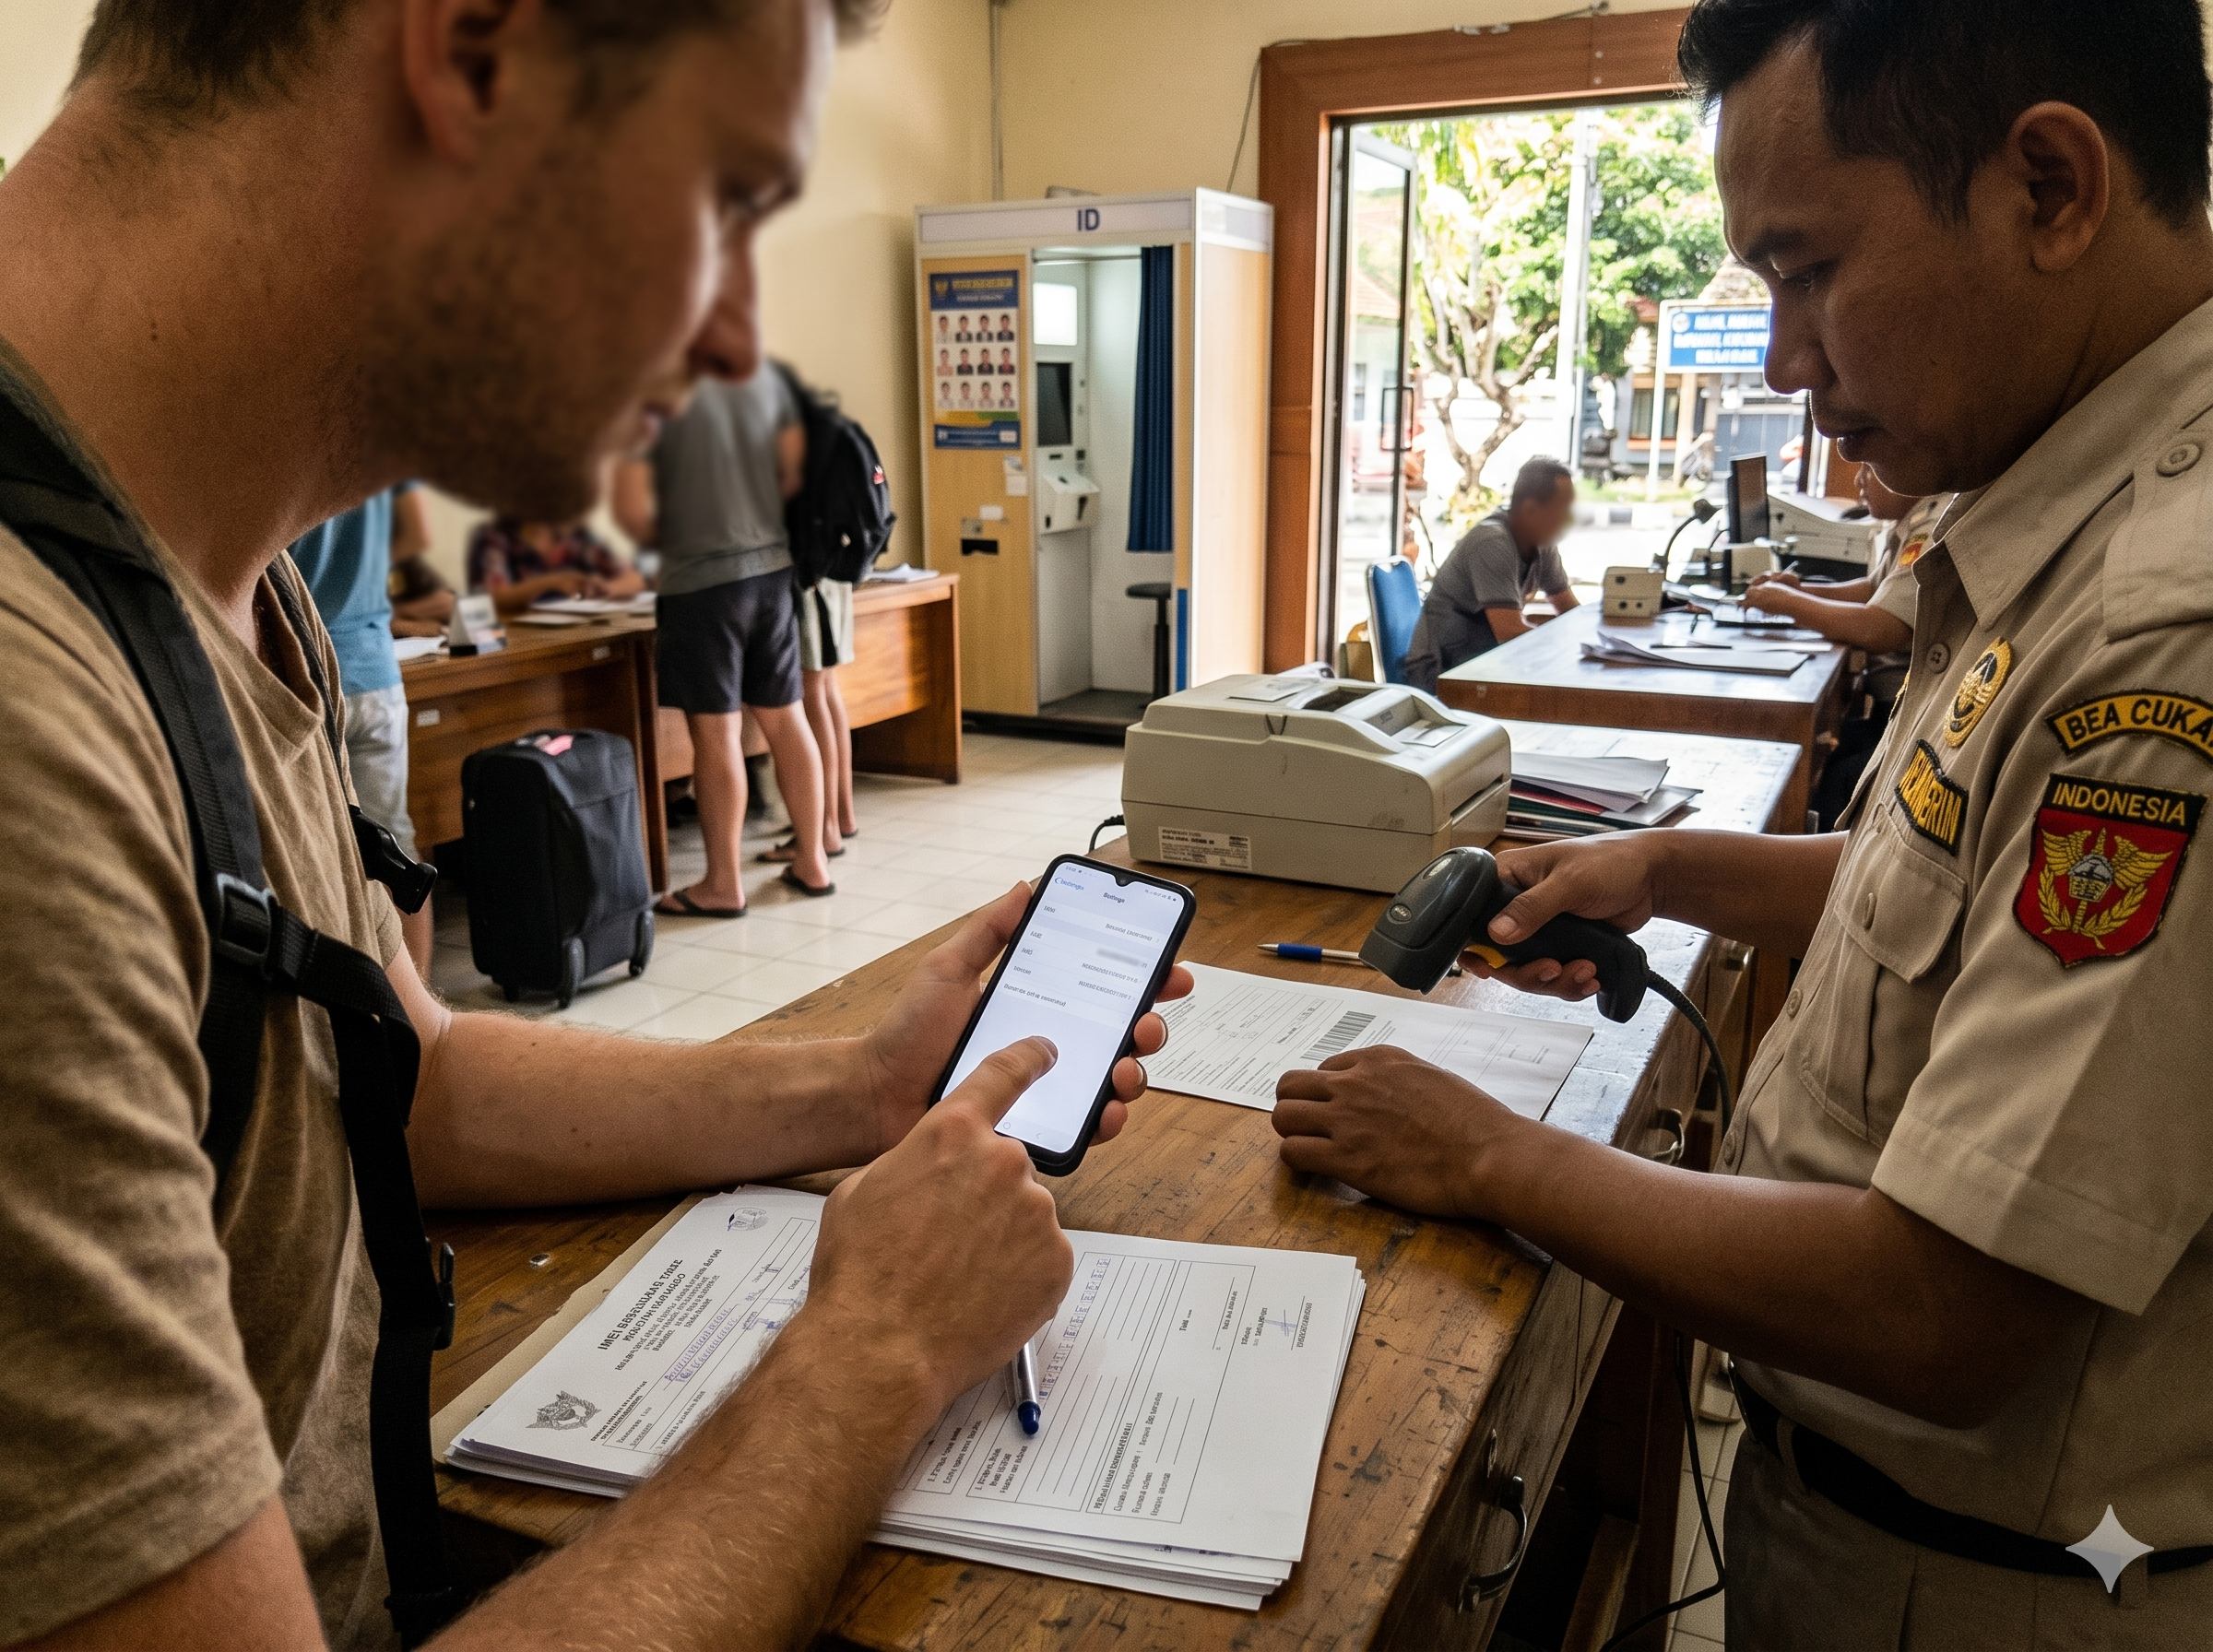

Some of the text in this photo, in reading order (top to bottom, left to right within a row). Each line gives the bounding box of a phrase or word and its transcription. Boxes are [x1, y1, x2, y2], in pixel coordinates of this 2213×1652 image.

[1077, 208, 1100, 231] ID
[2065, 699, 2213, 748] BEA CUKA
[2052, 782, 2186, 827] INDONESIA
